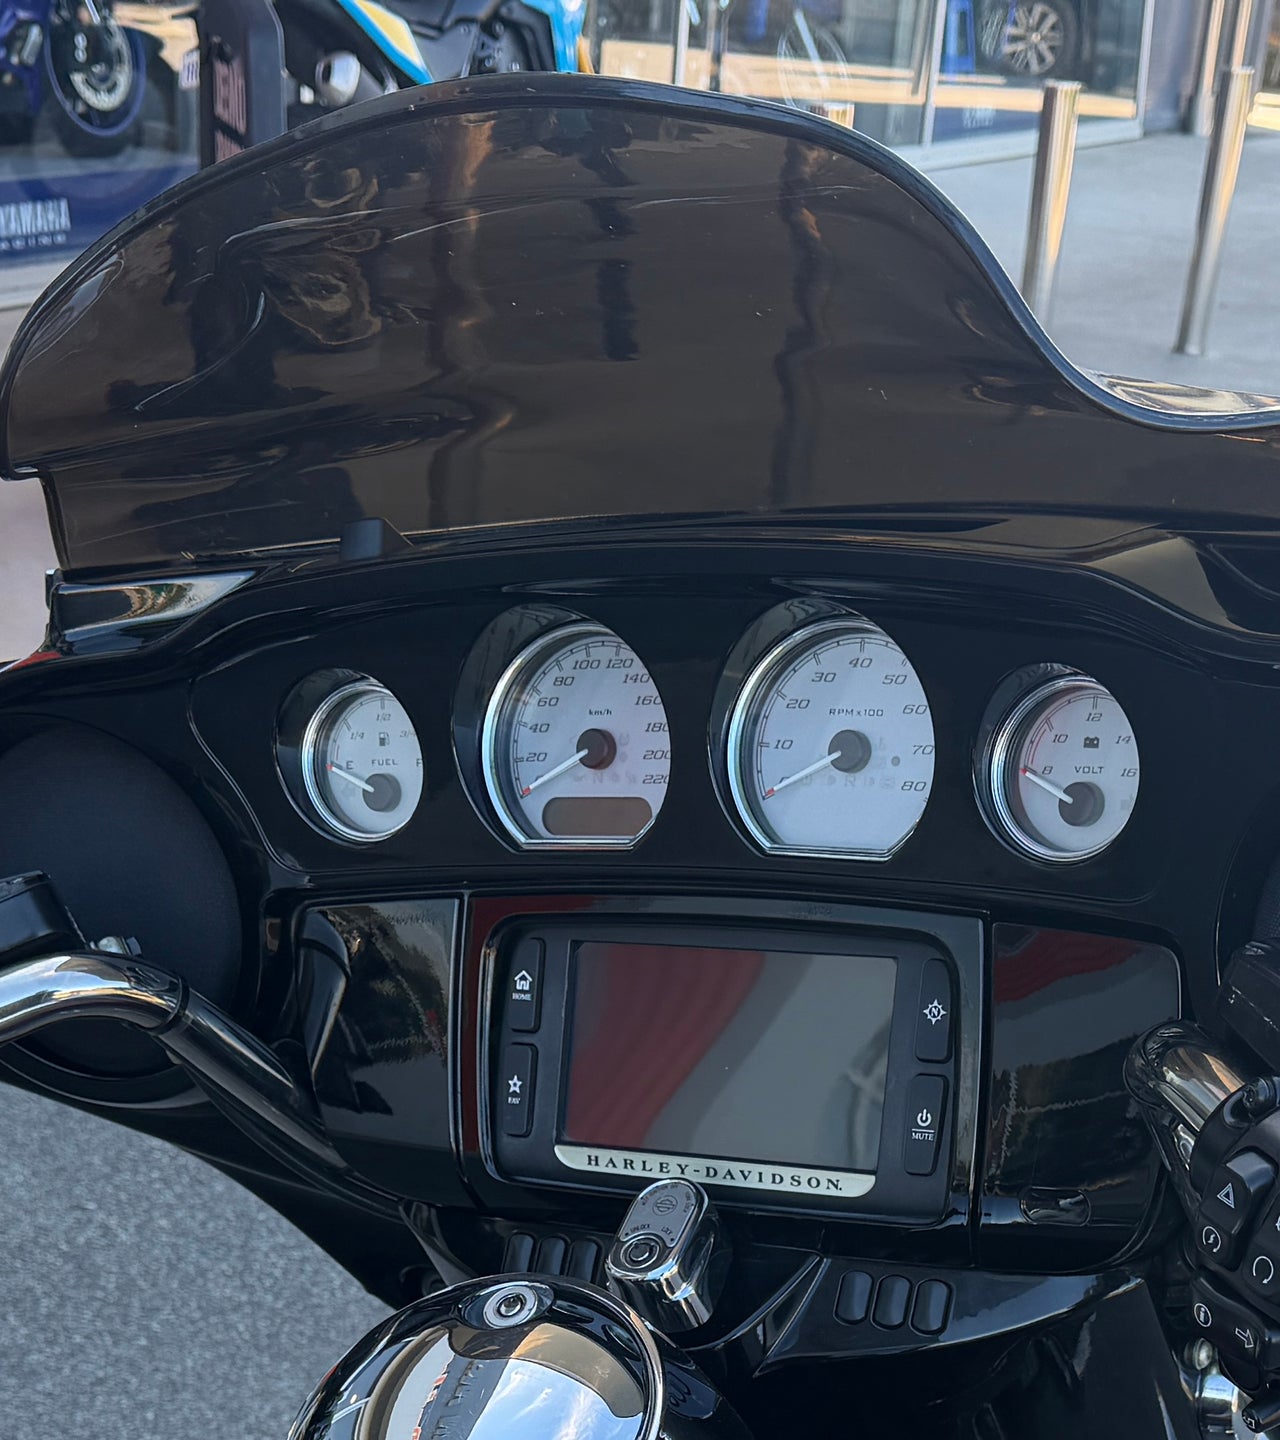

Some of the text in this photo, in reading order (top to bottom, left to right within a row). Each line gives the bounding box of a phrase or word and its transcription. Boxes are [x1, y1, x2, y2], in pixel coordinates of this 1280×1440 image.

[573, 659, 601, 670] 100
[605, 658, 634, 669] 120
[848, 657, 873, 668] 40
[553, 676, 575, 687] 80
[622, 673, 651, 684] 140
[811, 672, 837, 683] 30
[882, 674, 908, 685] 50
[537, 697, 559, 707] 60
[786, 699, 810, 709] 20
[588, 708, 612, 716] km/h
[829, 708, 854, 717] RPM
[902, 704, 928, 715] 60
[1086, 712, 1103, 722] 12
[529, 723, 550, 733] 40
[1052, 734, 1069, 743] 10
[1115, 735, 1131, 745] 14
[774, 739, 794, 750] 10
[912, 745, 934, 755] 70
[371, 758, 398, 766] FUEL
[525, 752, 548, 763] 20
[346, 760, 354, 770] E
[1041, 765, 1054, 775] 8
[1074, 766, 1104, 774] VOLT
[1120, 768, 1138, 777] 16
[901, 781, 927, 792] 80
[511, 992, 532, 1001] HOME
[507, 1096, 521, 1105] FAV
[911, 1132, 934, 1141] MUTE
